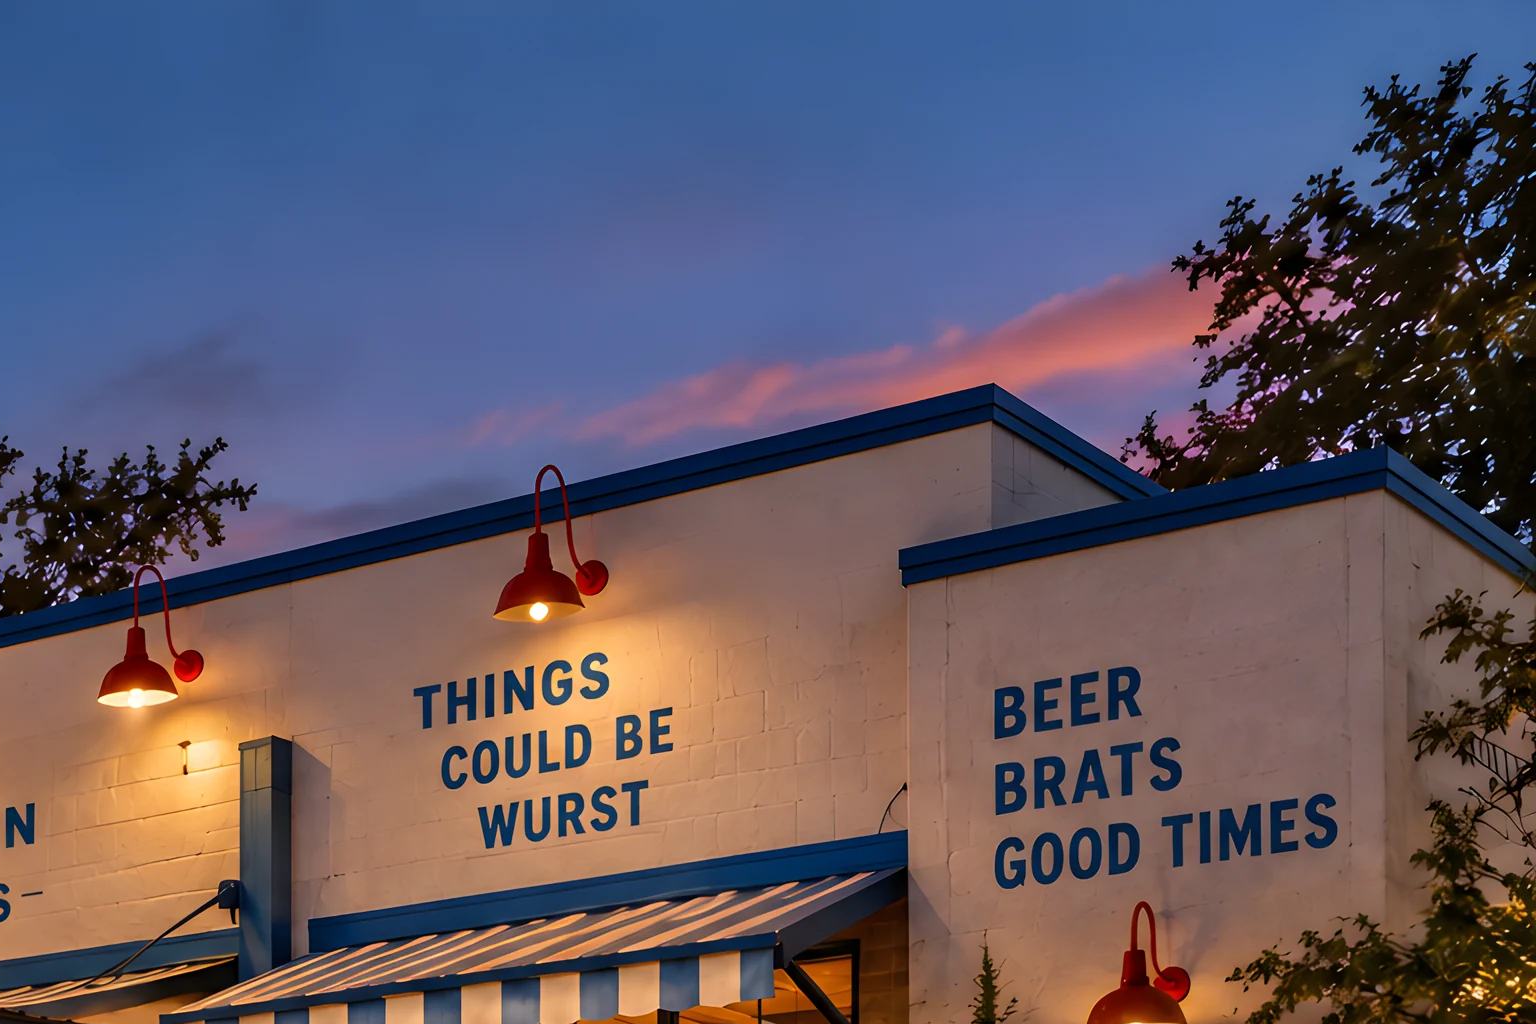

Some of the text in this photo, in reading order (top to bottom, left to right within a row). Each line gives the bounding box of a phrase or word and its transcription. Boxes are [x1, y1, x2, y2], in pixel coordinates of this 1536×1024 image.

[413, 652, 610, 729] THINGS
[993, 665, 1142, 740] BEER
[440, 706, 674, 790] COULD BE
[995, 736, 1183, 816] BRATS
[477, 779, 649, 849] WURST
[994, 793, 1338, 889] GOOD TIMES
